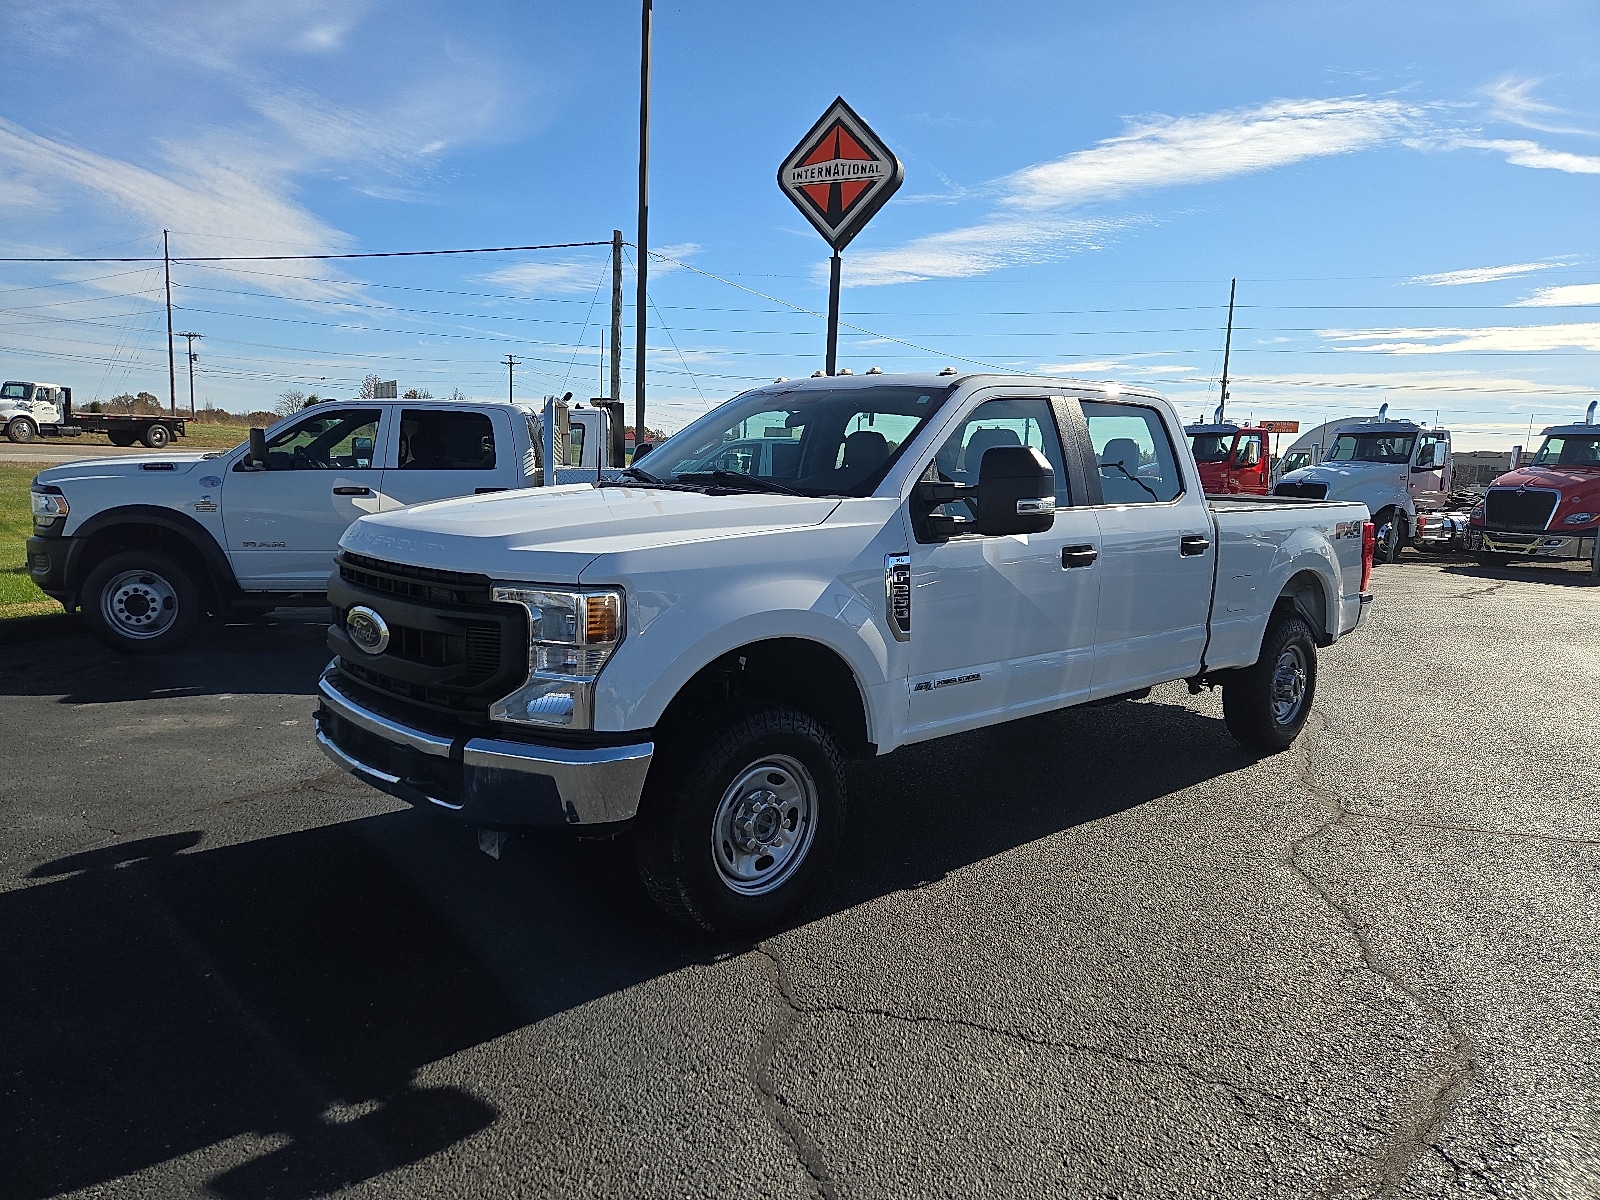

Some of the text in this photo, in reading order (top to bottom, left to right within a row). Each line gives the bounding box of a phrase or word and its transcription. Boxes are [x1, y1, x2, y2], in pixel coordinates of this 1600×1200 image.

[792, 162, 881, 181] INTERNATIONAL
[1336, 520, 1361, 540] FX4
[353, 617, 378, 642] Ford
